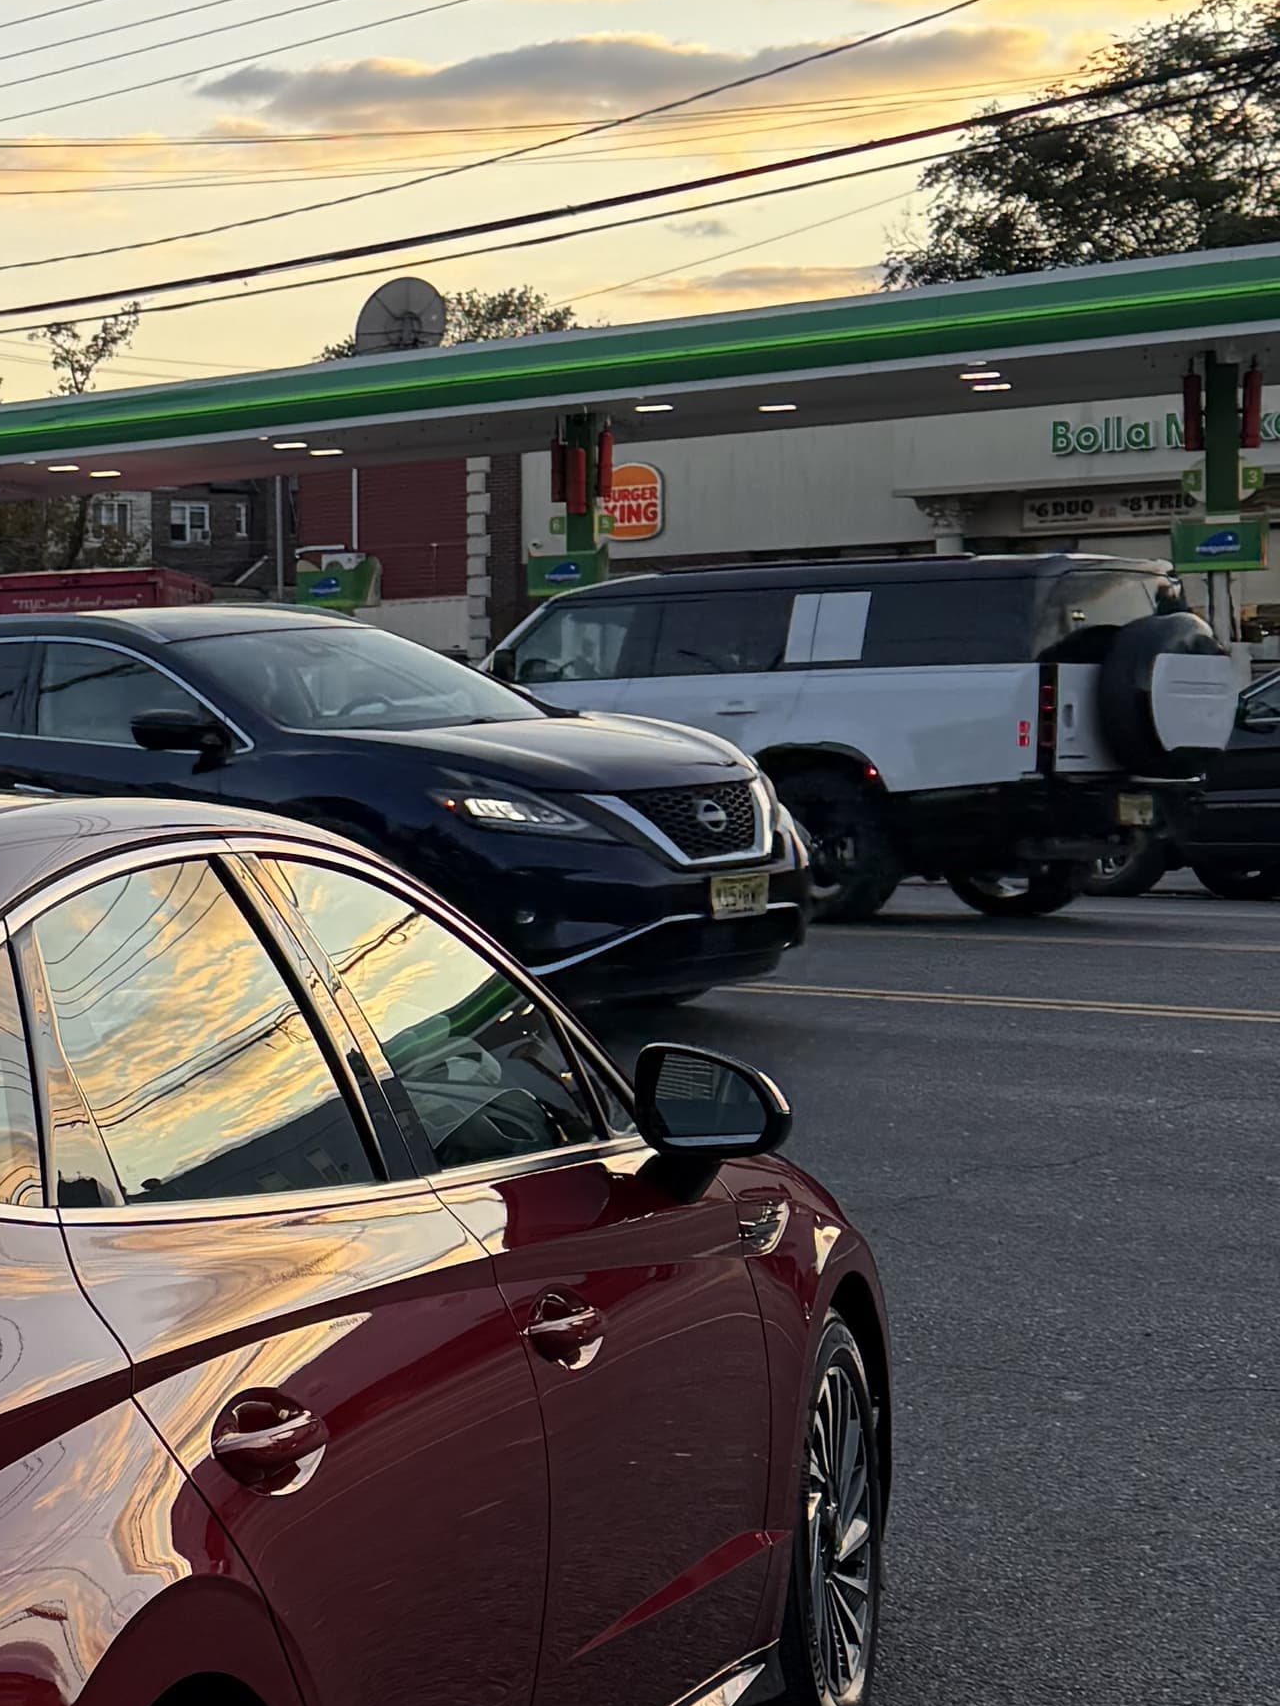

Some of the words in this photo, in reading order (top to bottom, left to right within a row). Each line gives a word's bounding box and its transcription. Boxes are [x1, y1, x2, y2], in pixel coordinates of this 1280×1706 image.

[1051, 415, 1153, 455] Bolla
[1249, 470, 1258, 484] 3
[1051, 498, 1094, 516] DUO
[1141, 492, 1198, 511] TRIO
